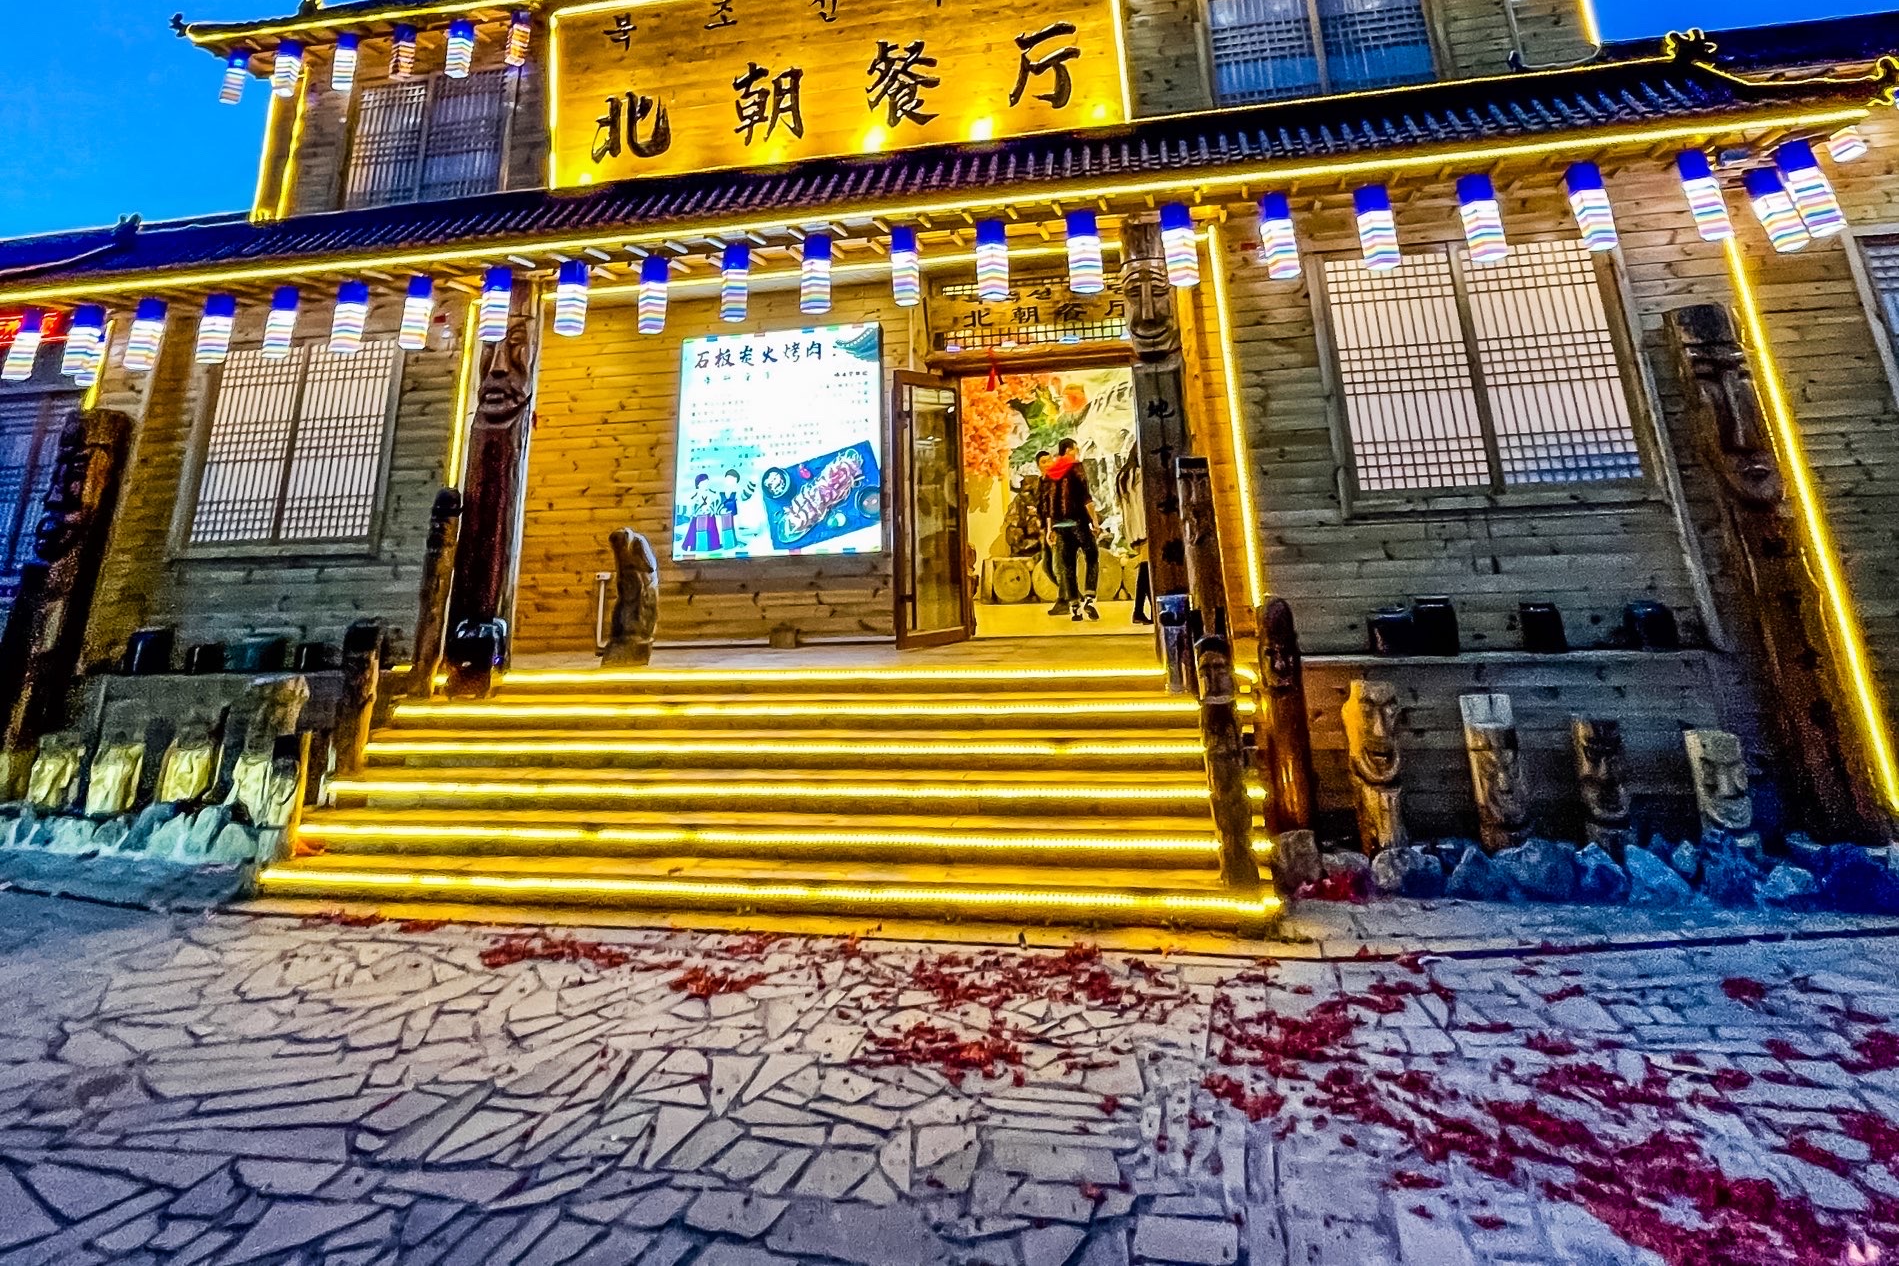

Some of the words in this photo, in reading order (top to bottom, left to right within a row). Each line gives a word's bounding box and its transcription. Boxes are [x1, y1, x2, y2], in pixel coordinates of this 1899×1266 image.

[591, 21, 1082, 164] 北朝餐厅
[694, 340, 823, 370] 石板炭火烤肉
